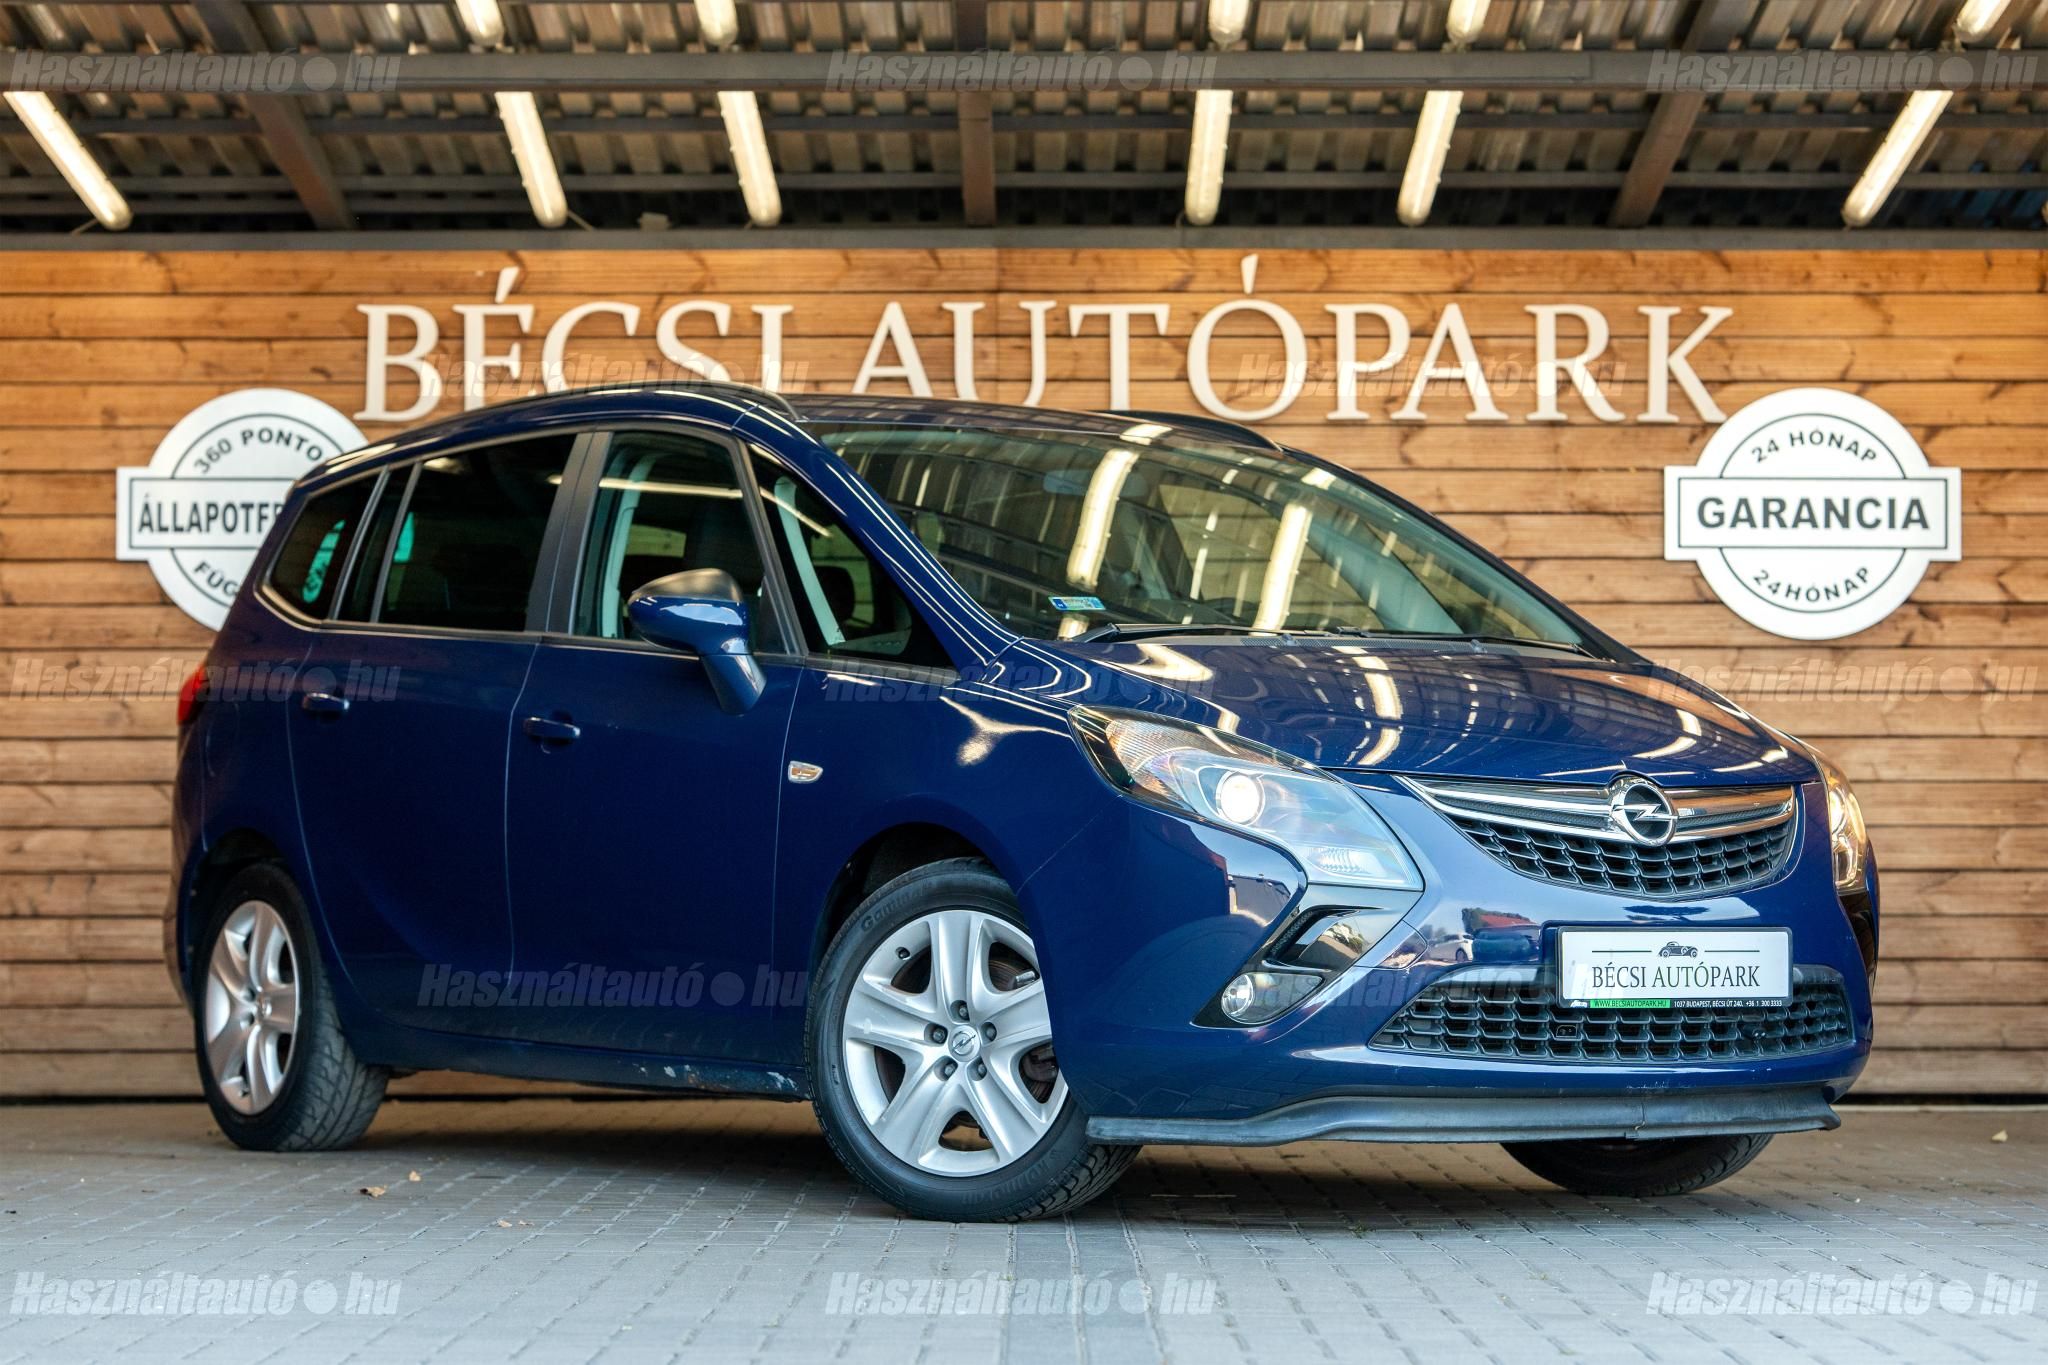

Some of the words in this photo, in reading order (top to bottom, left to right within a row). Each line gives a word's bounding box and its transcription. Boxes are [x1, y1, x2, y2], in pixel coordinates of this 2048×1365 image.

[351, 265, 795, 424] BÉCSI
[851, 253, 1734, 424] AUTÓPARK
[194, 437, 233, 475] 360
[240, 427, 323, 462] PONTO
[1751, 438, 1780, 463] 24
[1788, 426, 1877, 464] HÓNAP
[1697, 497, 1930, 529] GARANCIA
[1591, 961, 1647, 988] BÉCSI
[1651, 961, 1761, 988] AUTÓPARK
